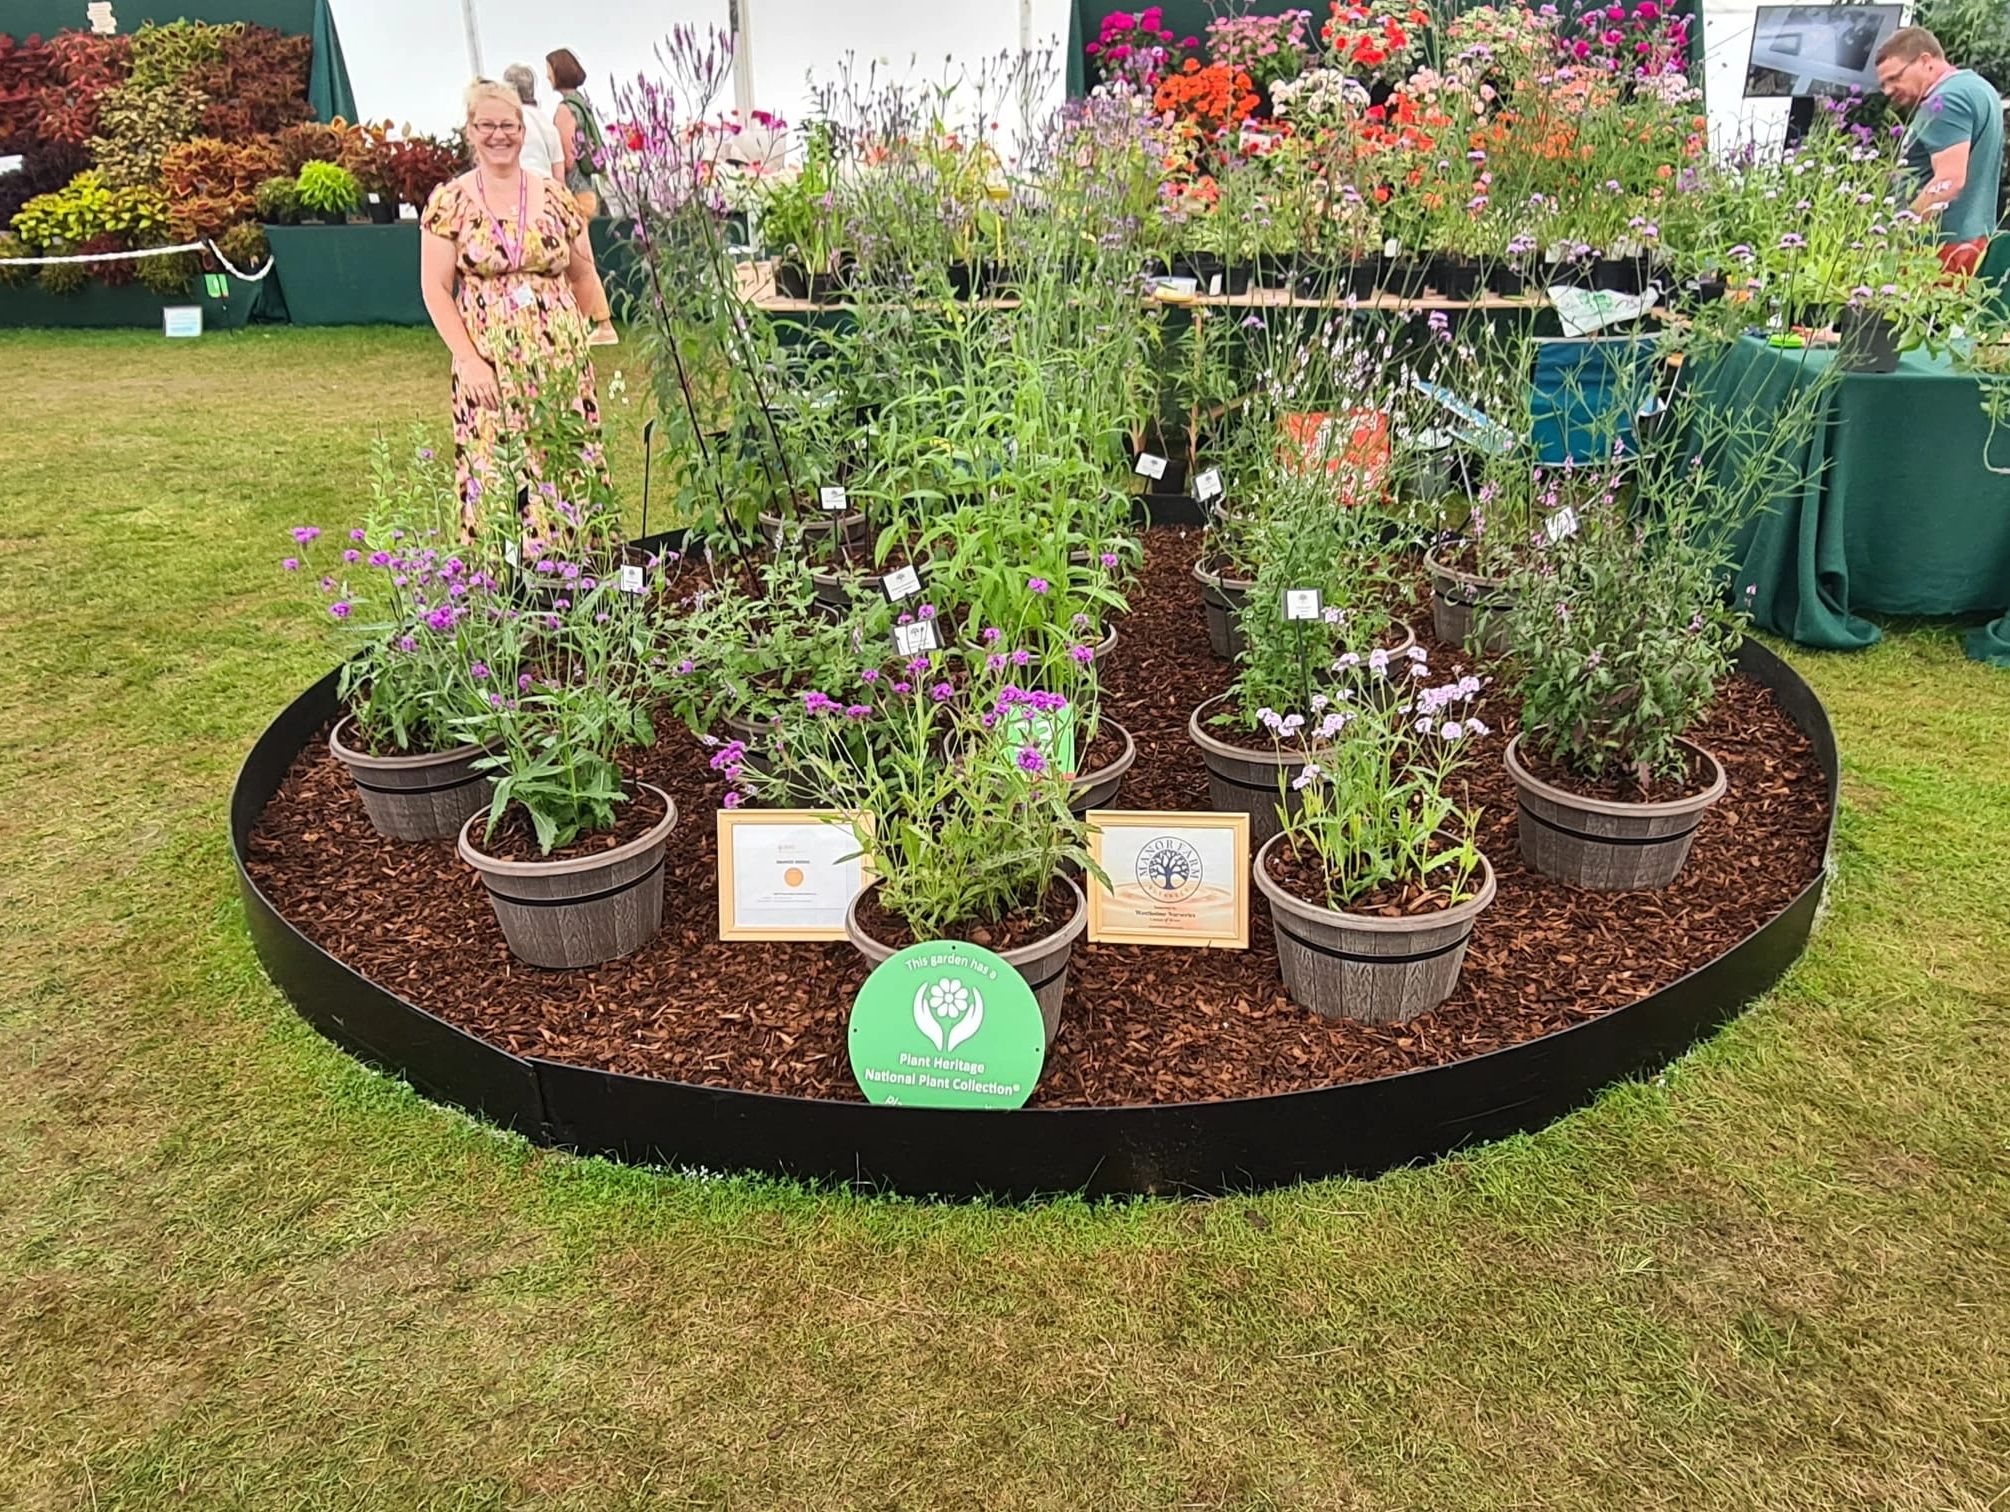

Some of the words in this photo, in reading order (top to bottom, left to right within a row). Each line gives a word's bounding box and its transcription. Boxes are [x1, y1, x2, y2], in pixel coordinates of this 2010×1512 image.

[1138, 839, 1173, 876] MANOR
[1177, 842, 1200, 878] FARM
[905, 957, 928, 971] This
[930, 953, 968, 967] garden
[970, 959, 989, 975] has
[989, 970, 997, 979] a
[900, 1053, 931, 1067] Plant
[933, 1056, 985, 1075] Heritage
[865, 1069, 916, 1085] National
[919, 1074, 950, 1089] Plant
